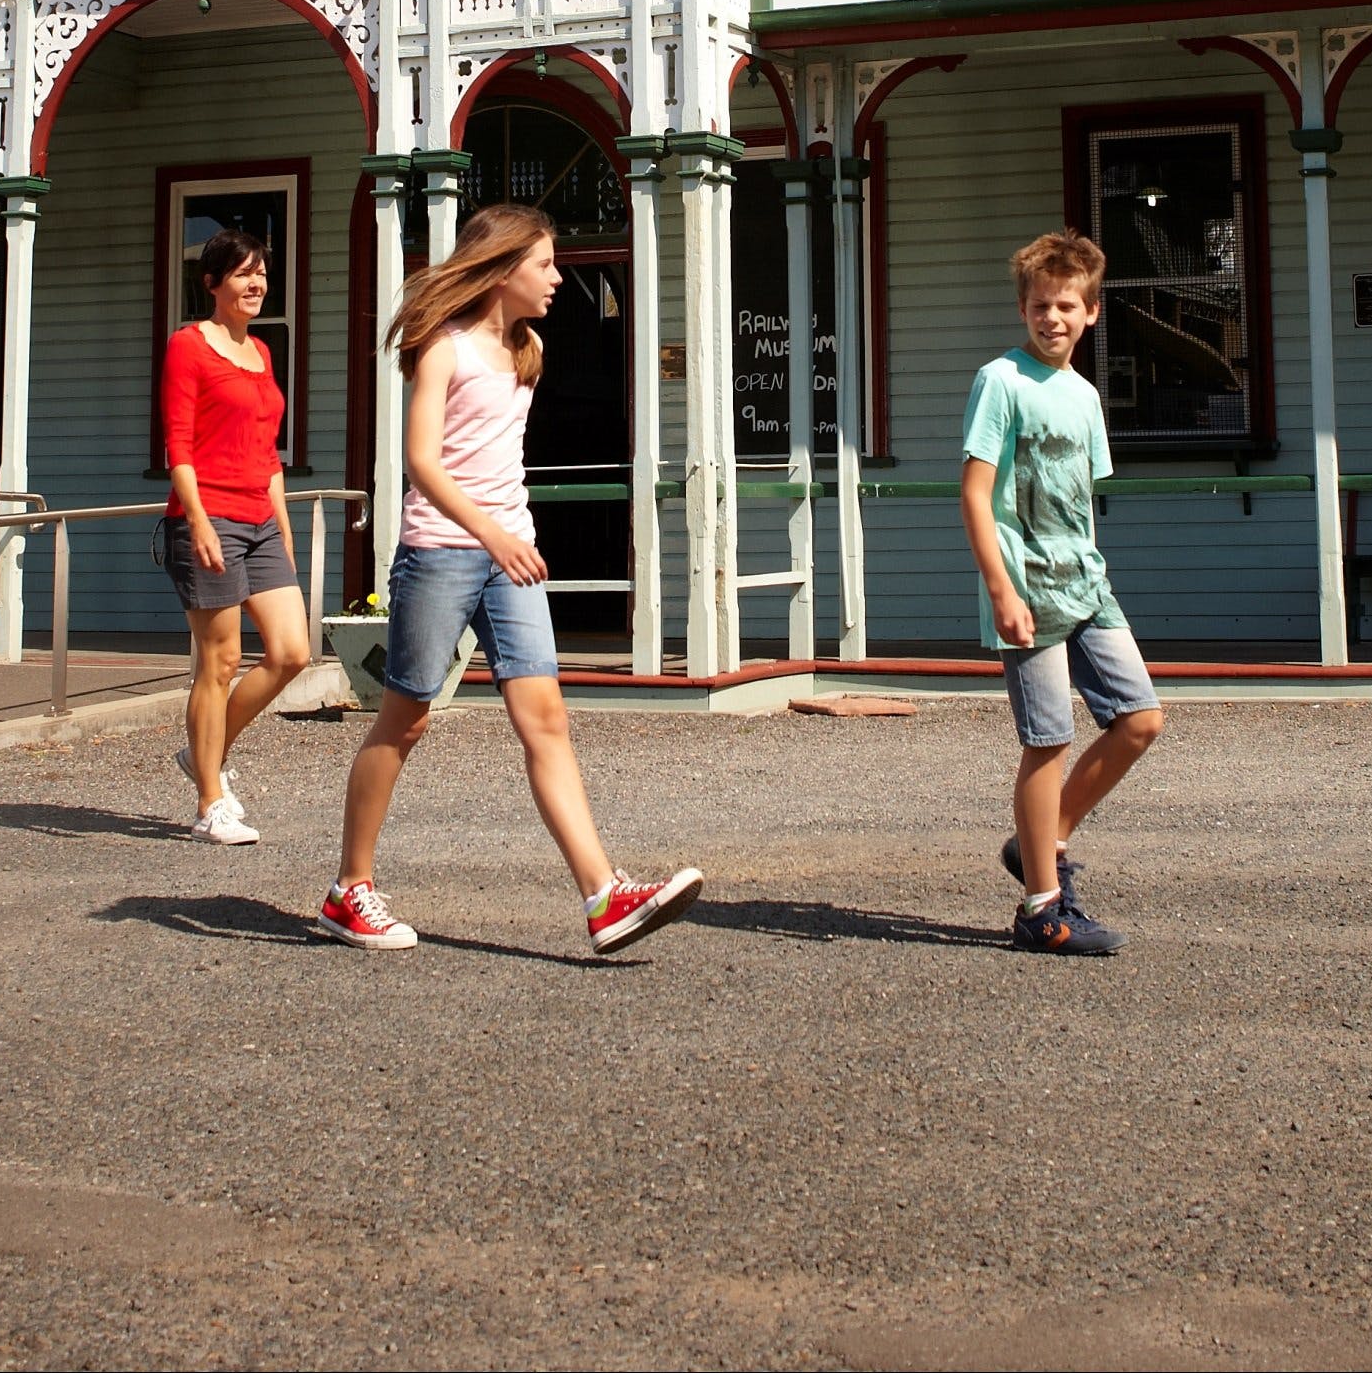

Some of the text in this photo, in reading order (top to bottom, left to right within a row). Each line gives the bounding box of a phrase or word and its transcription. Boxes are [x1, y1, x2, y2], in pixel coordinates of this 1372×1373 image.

[738, 309, 818, 336] RAILW
[754, 334, 837, 360] MUSM
[734, 371, 784, 392] OPEN
